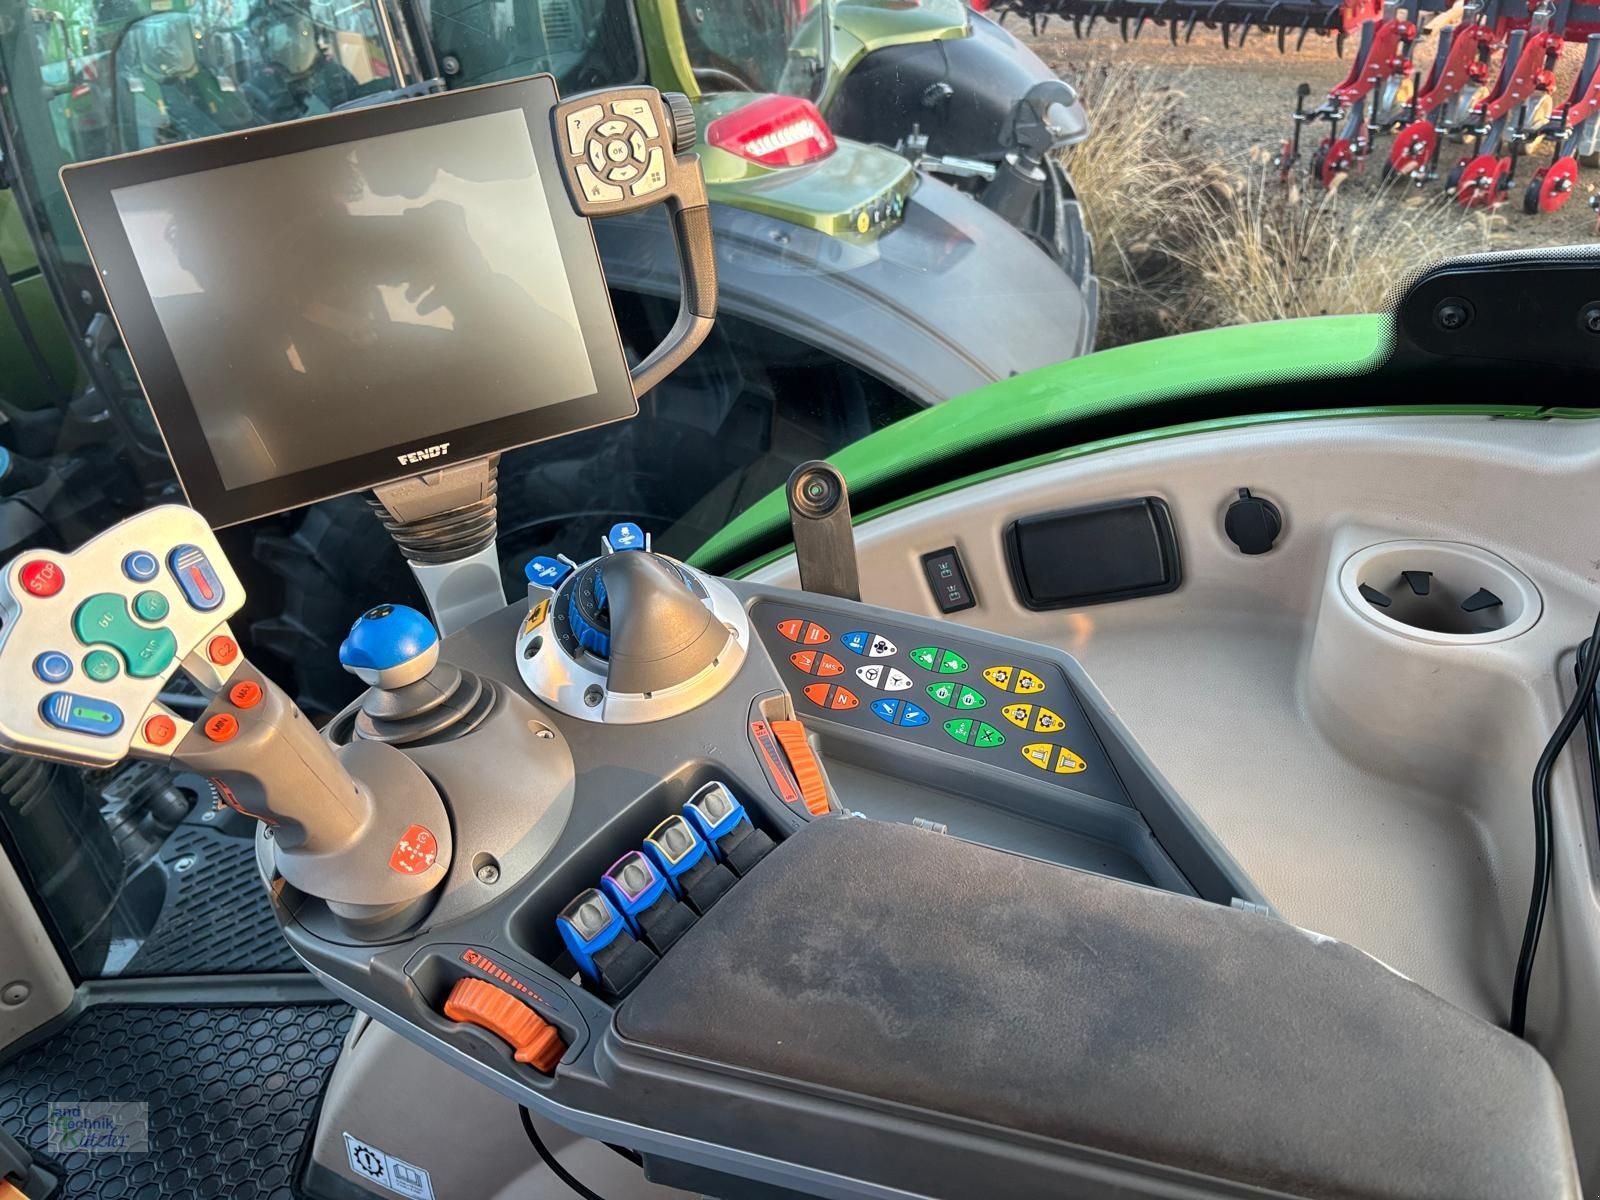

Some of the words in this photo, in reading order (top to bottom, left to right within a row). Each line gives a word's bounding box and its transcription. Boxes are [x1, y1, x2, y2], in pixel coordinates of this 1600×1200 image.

[612, 147, 624, 155] OK
[397, 442, 450, 466] FENDT
[30, 562, 54, 591] STOP
[217, 642, 234, 658] C2
[822, 662, 836, 671] TMS
[236, 684, 252, 700] MAX
[837, 694, 848, 705] N
[212, 717, 229, 733] MIN
